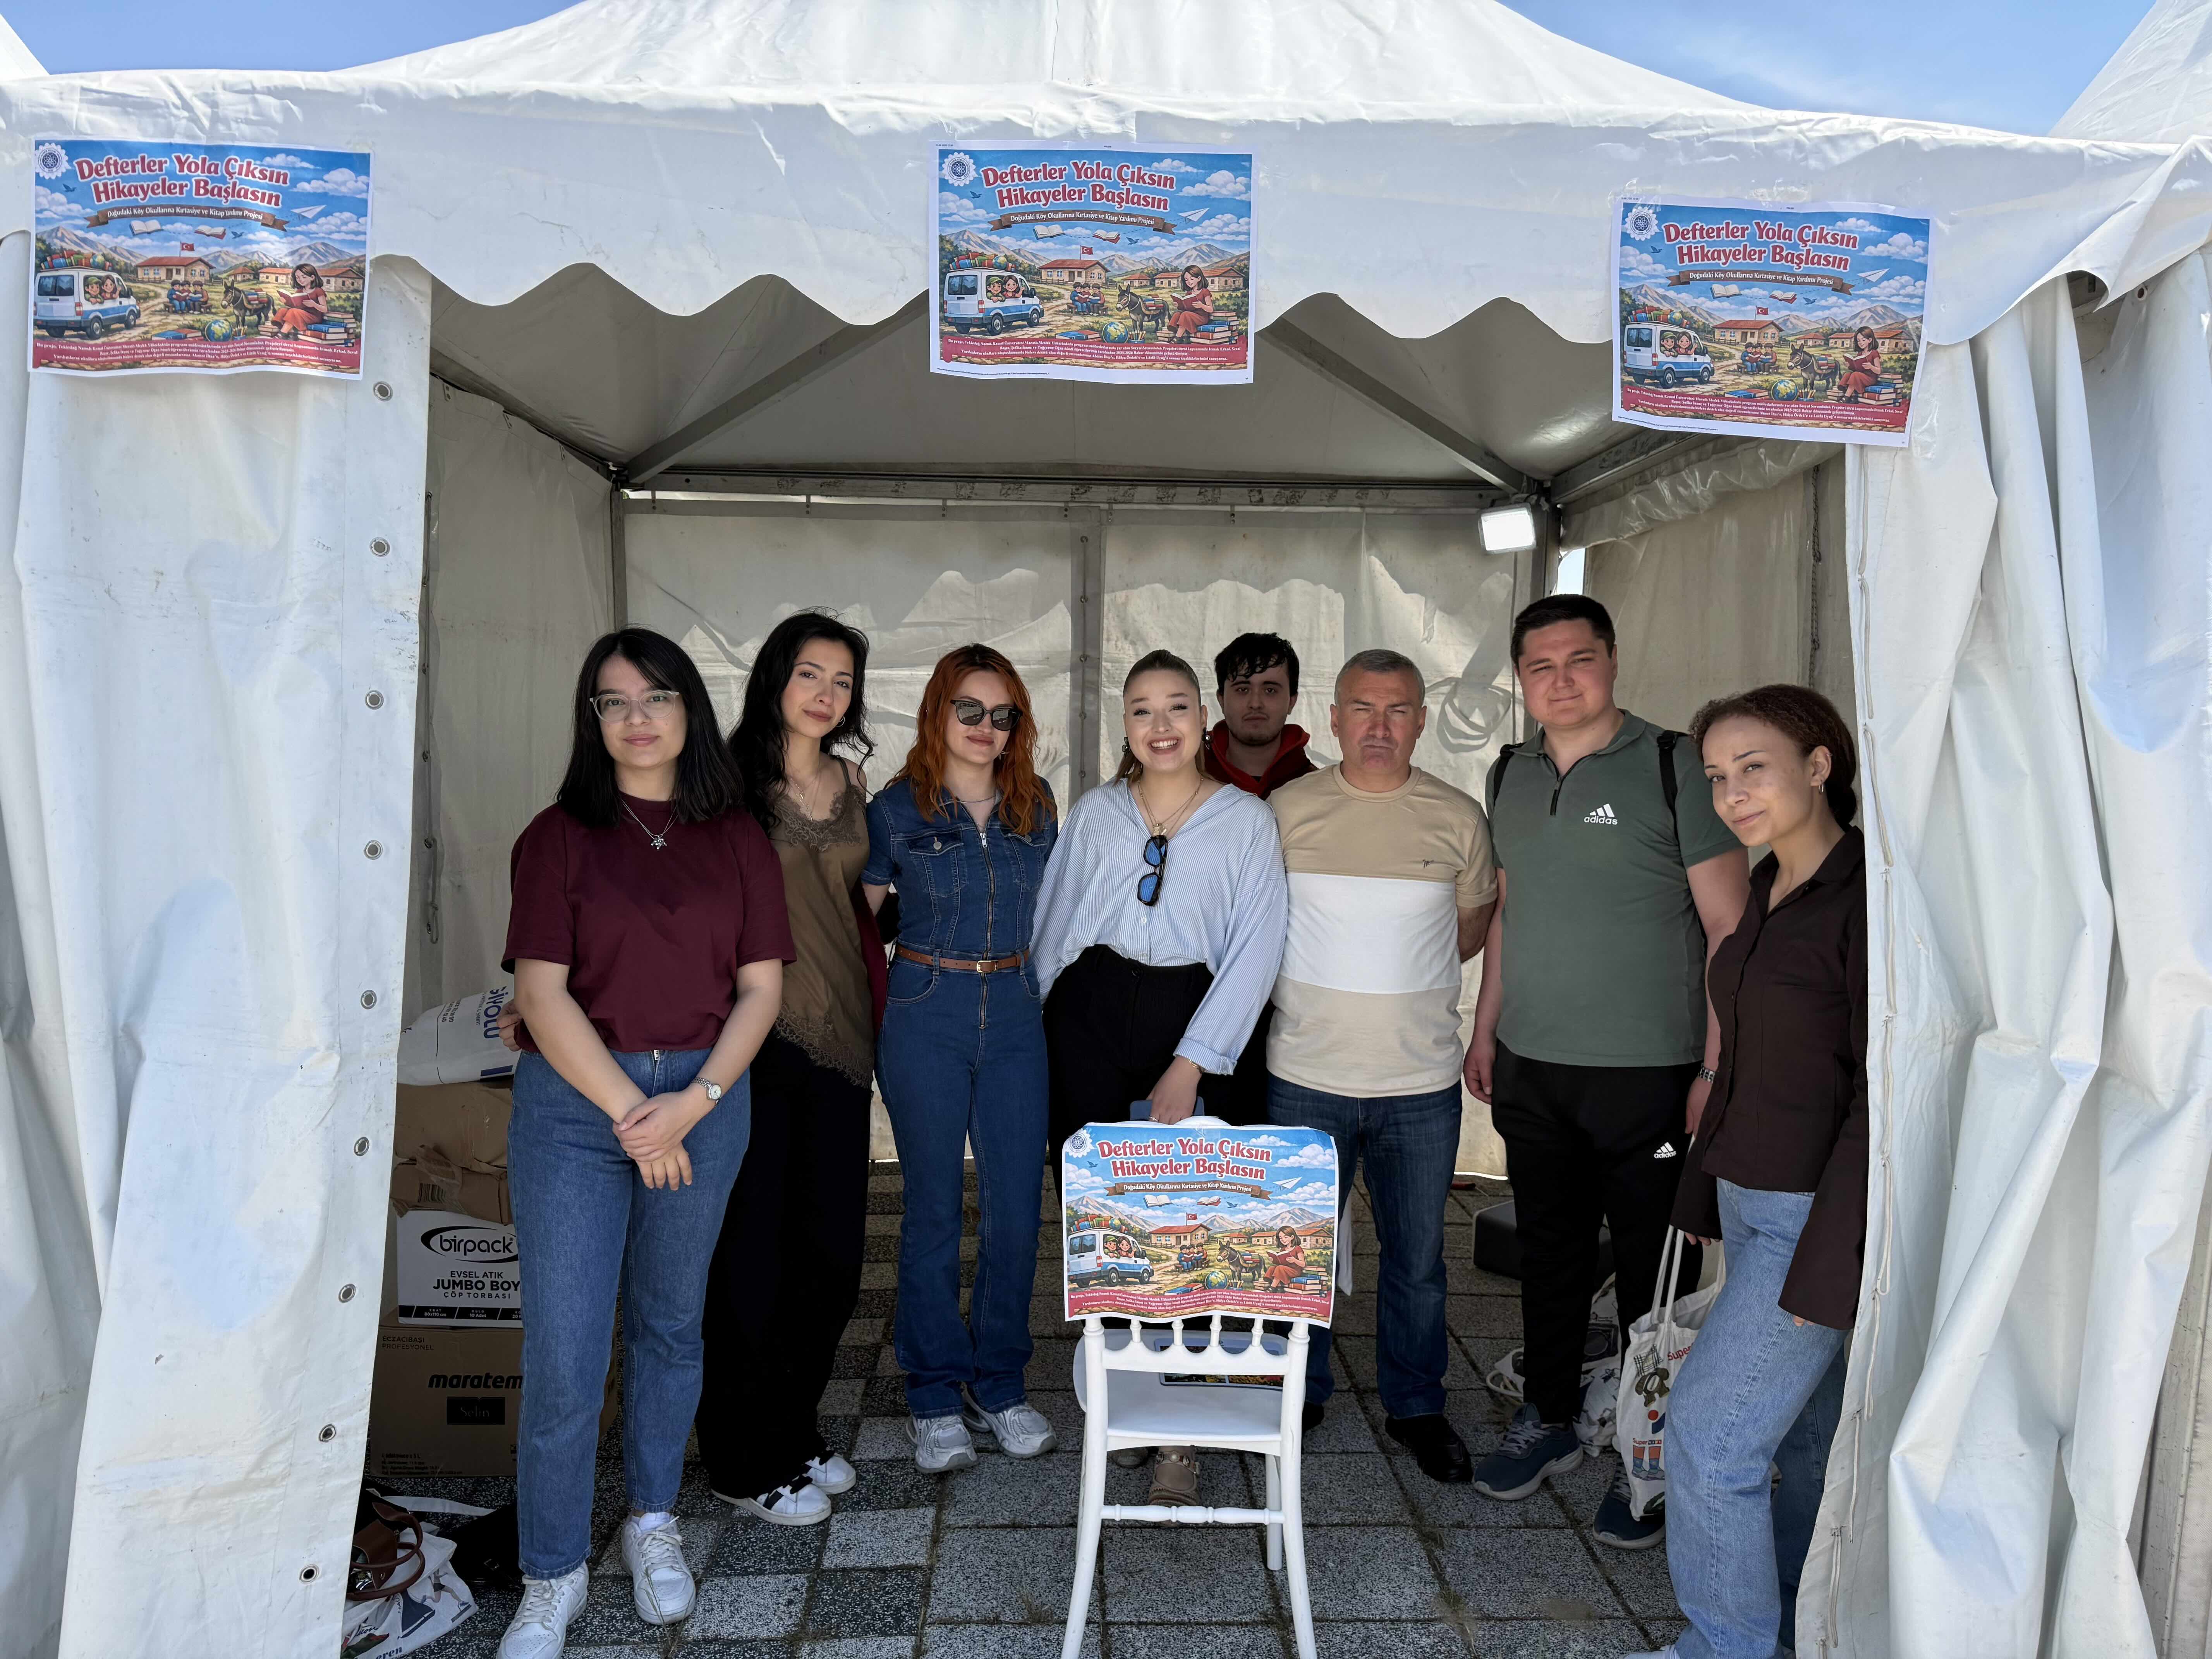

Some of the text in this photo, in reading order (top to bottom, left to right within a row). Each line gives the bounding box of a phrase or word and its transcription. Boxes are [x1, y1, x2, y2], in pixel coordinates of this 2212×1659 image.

[76, 155, 168, 179] Defterler
[173, 155, 219, 175] Yola
[225, 158, 289, 184] Çıksın
[982, 164, 1066, 187] Defterler
[1072, 162, 1112, 180] Yola
[1117, 165, 1175, 189] Çıksın
[93, 178, 280, 205] Hikayeler Başlasın
[997, 185, 1168, 210] Hikayeler Başlasın
[108, 208, 132, 217] Doğudaki
[176, 207, 201, 215] Kırtasiye
[210, 209, 224, 218] Kitap
[244, 210, 263, 220] Projesi
[1011, 214, 1035, 222] Doğudaki
[1105, 214, 1118, 222] Kitap
[1139, 217, 1154, 225] Projesi
[1664, 222, 1749, 242] Defterler
[1755, 222, 1793, 240] Yola
[1798, 225, 1858, 247] Çıksın
[1678, 244, 1849, 270] Hikayeler Başlasın
[1783, 275, 1795, 283] Kitap
[1817, 277, 1834, 285] Projesi
[1584, 816, 1618, 825] adidas
[1097, 1139, 1270, 1161] Defterler Yola Çıksın
[1654, 1151, 1676, 1159] adidas
[1112, 1159, 1265, 1180] Hikayeler Başlasın
[440, 1235, 514, 1256] birpack
[433, 1279, 520, 1291] JUMBO BOY
[428, 1372, 523, 1389] maratem
